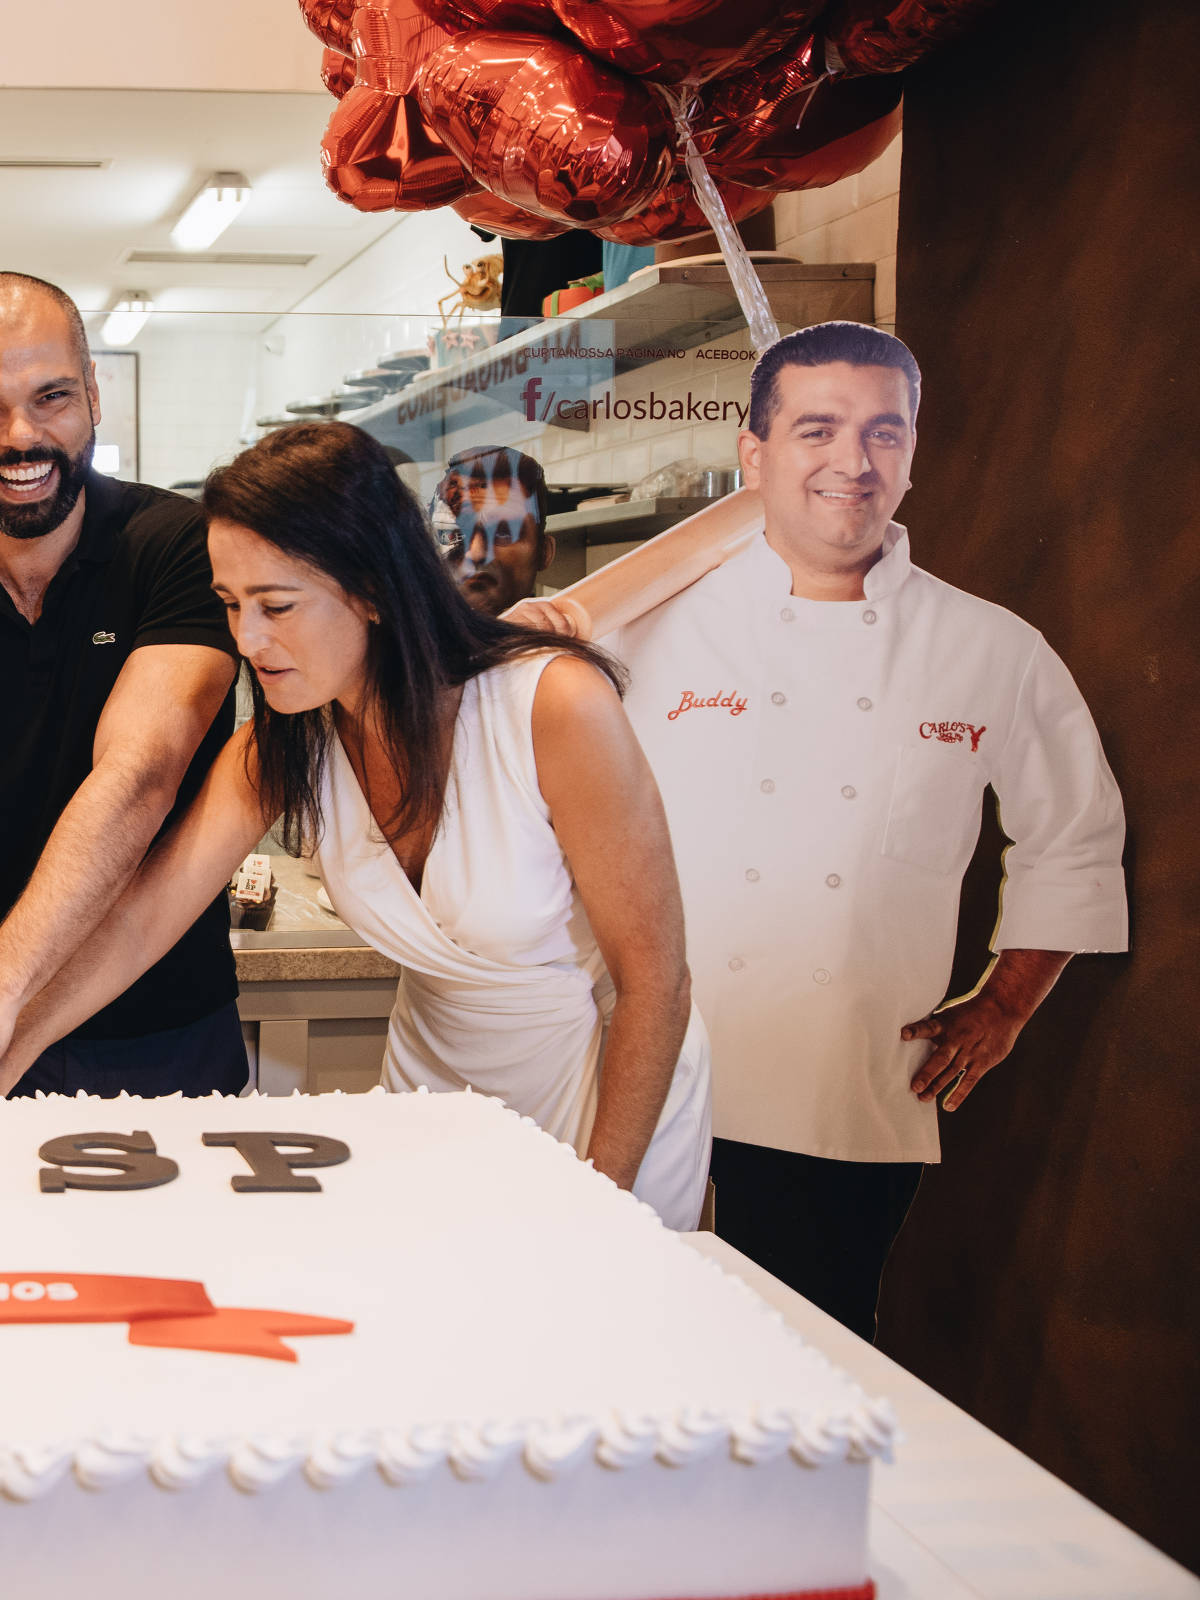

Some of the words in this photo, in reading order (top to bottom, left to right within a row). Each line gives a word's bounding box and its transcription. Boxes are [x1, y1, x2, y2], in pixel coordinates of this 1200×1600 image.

[523, 347, 566, 359] CURTA
[569, 347, 614, 359] NOSSA
[667, 348, 686, 360] NO
[667, 689, 748, 721] Buddy
[38, 1130, 352, 1194] SP
